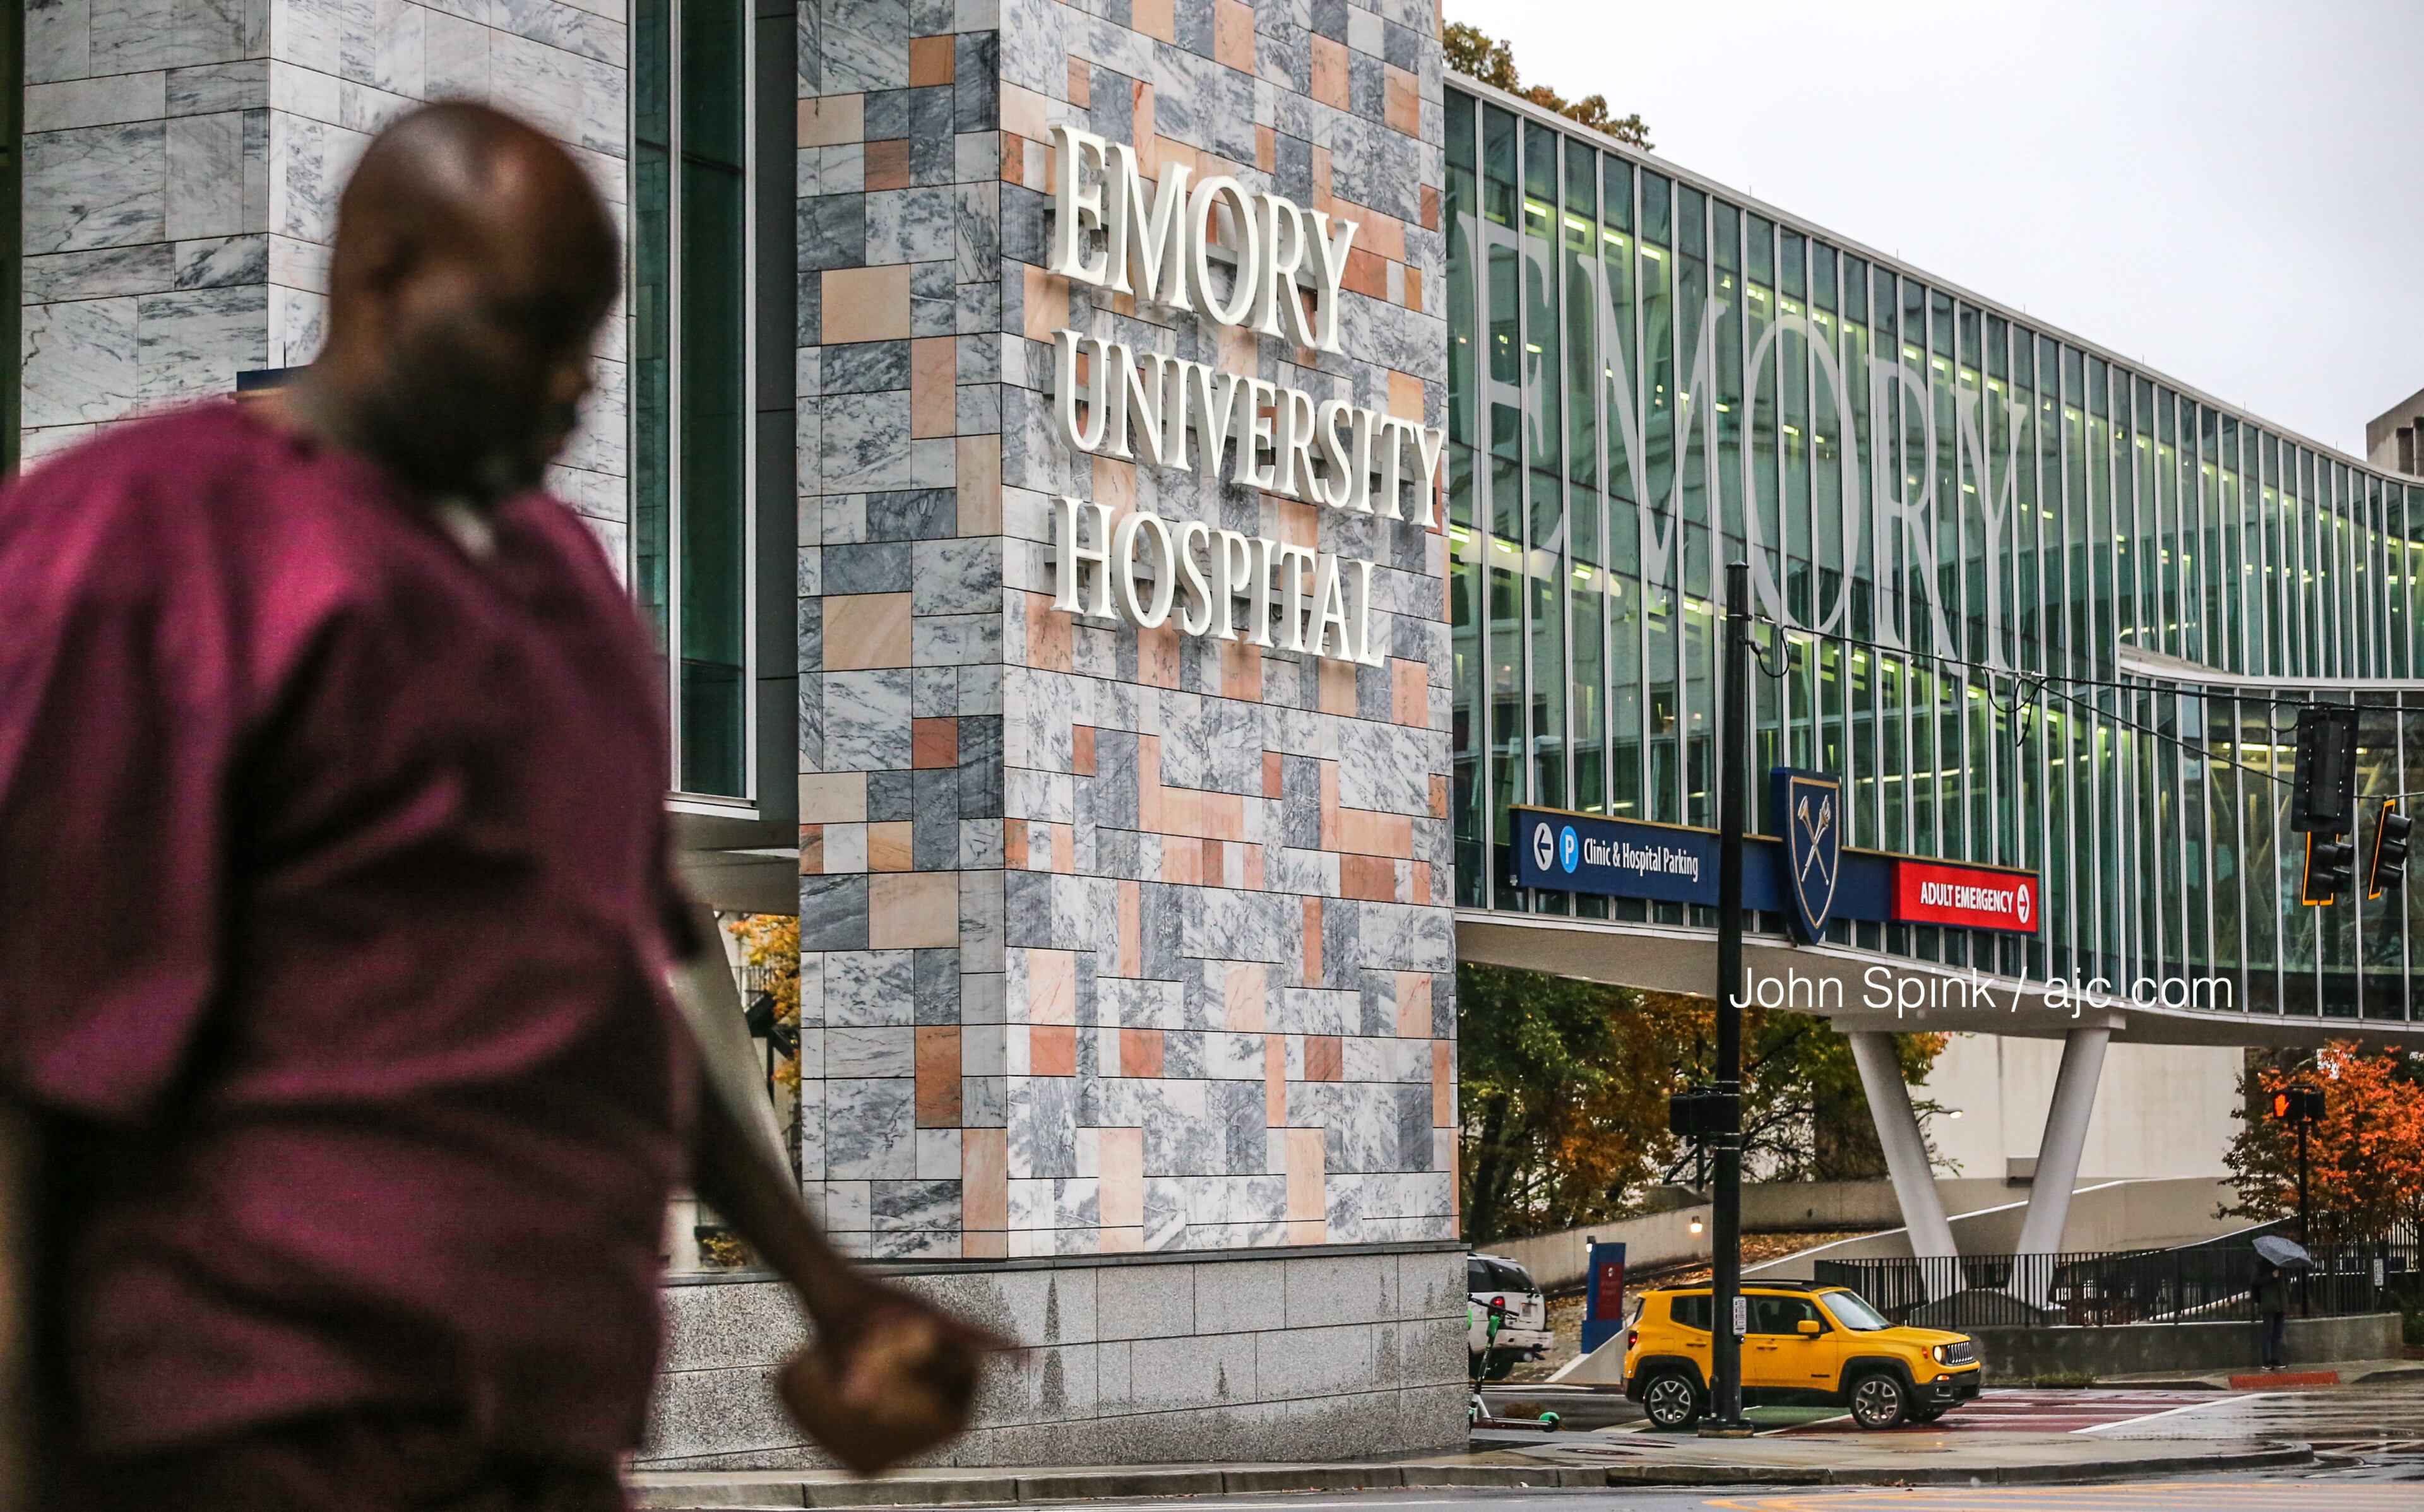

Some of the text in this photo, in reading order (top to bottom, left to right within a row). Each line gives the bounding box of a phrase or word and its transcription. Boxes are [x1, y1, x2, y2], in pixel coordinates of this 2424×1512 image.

[1047, 124, 1358, 355] EMORY
[1050, 328, 1446, 530] UNIVERSITY
[1456, 210, 2027, 678] EMORY
[1049, 495, 1385, 668] HOSPITAL
[1565, 834, 1699, 883] P Clinic & Hospital Parking
[1920, 882, 2014, 914] ADULT EMERGENCY
